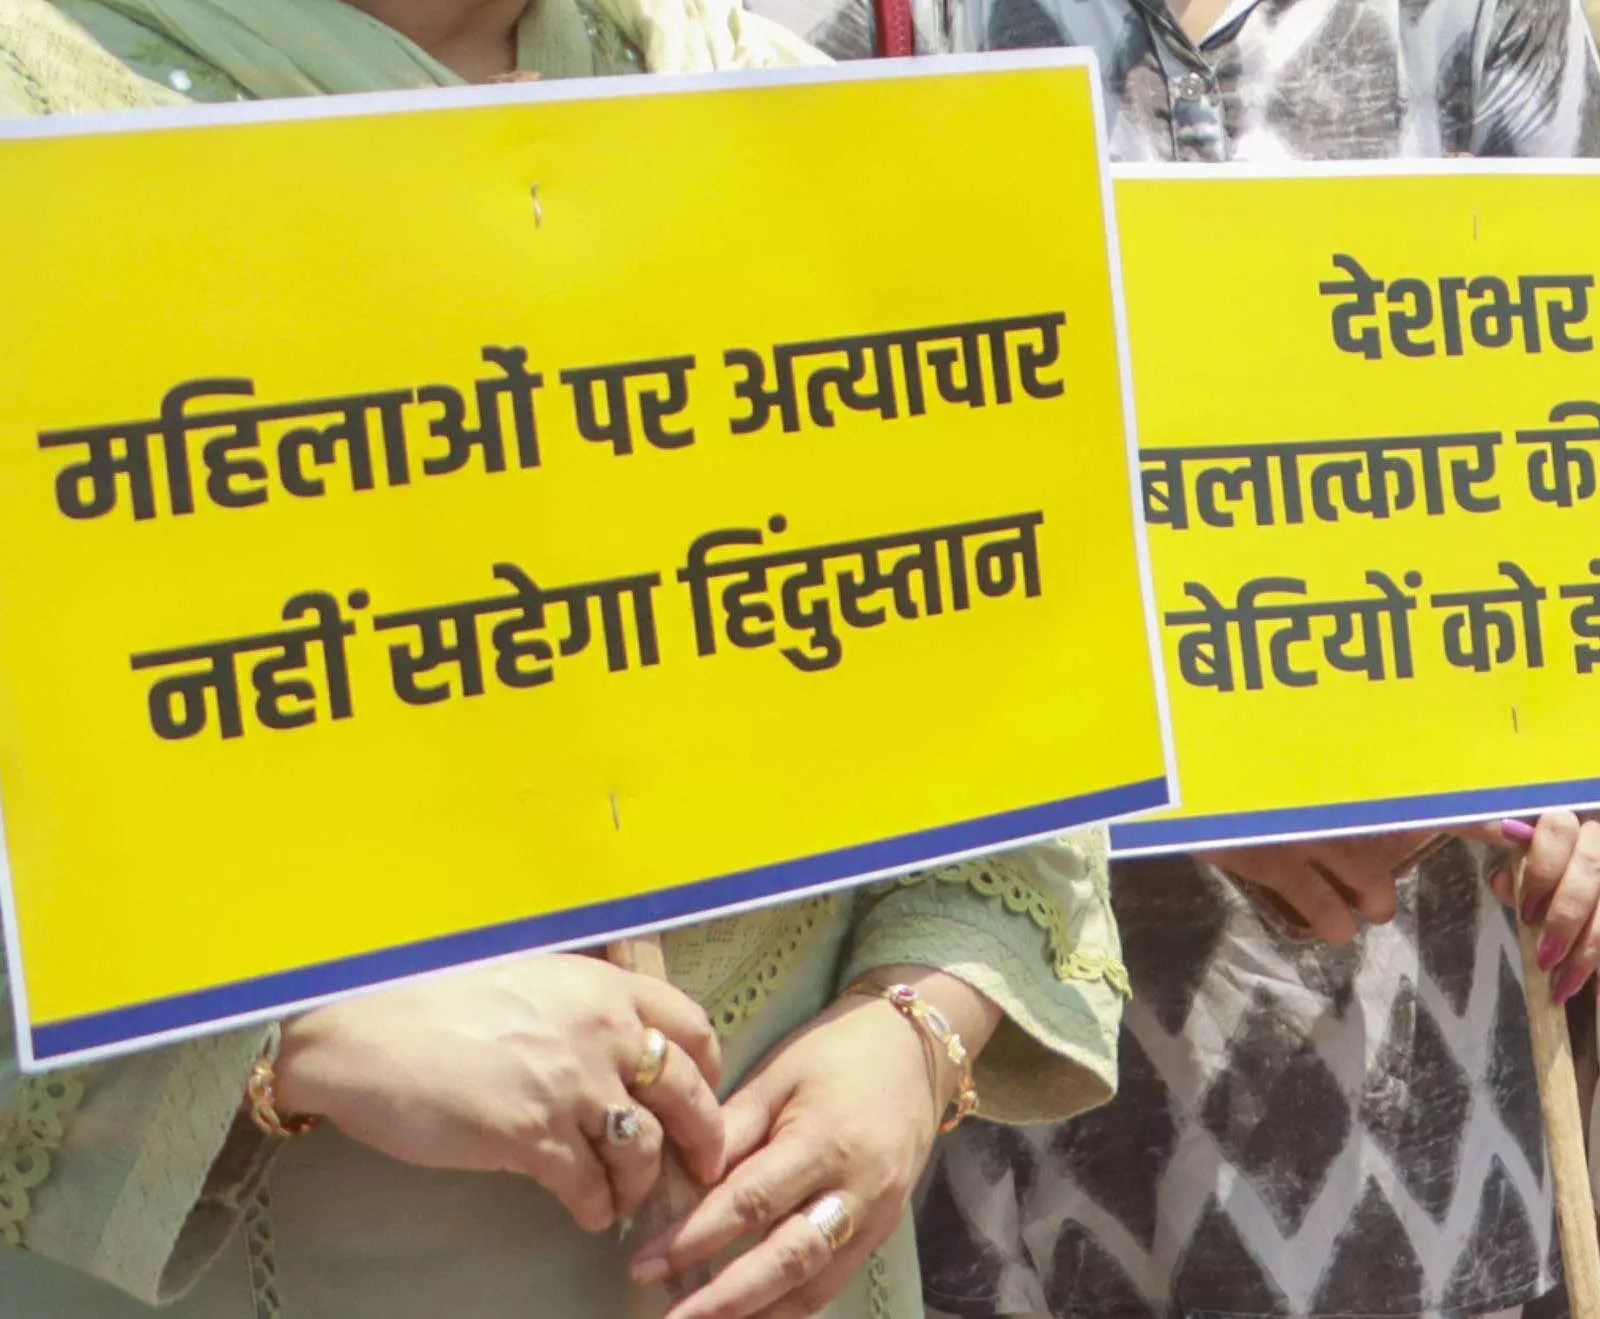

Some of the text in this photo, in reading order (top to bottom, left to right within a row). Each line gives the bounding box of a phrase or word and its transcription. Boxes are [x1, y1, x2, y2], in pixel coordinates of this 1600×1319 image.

[1319, 254, 1594, 359] देशभर
[38, 312, 1066, 521] महिलाओं पर अत्याचार
[1138, 432, 1502, 530] बलात्कार
[131, 511, 1043, 740] नहीं सहेगा हिंदुस्तान
[1165, 571, 1422, 692] बेटियों
[1431, 562, 1546, 672] को
